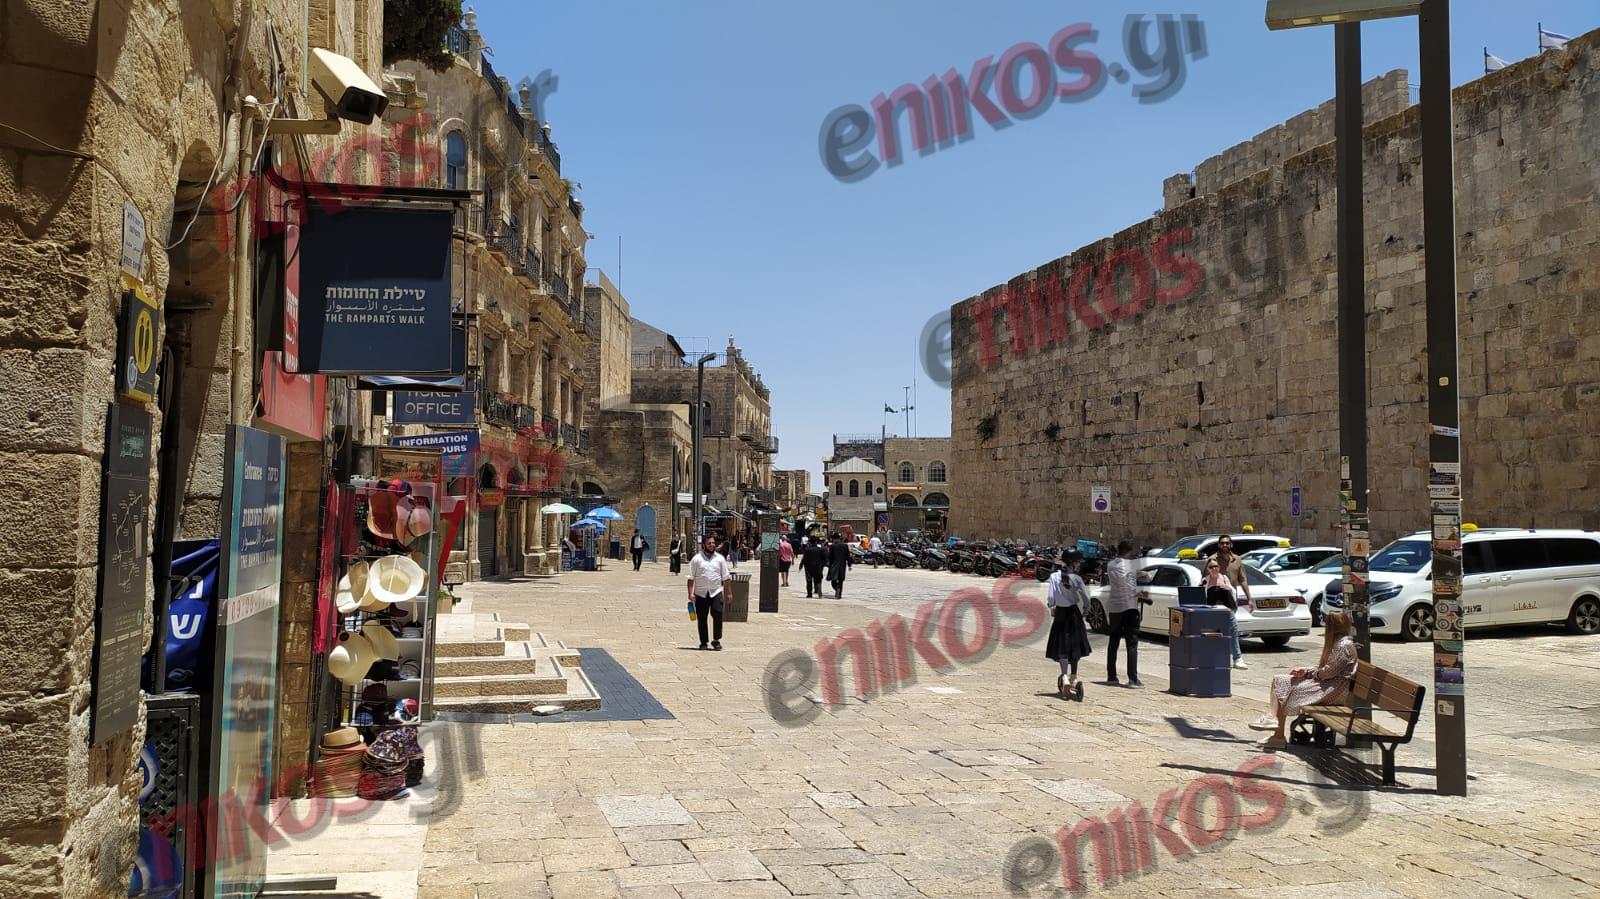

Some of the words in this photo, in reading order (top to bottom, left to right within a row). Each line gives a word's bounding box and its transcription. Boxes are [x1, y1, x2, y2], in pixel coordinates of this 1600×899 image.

[326, 286, 379, 300] החומות
[383, 286, 426, 300] טיילת
[325, 314, 343, 324] THE
[346, 314, 396, 325] RAMPARTS
[399, 315, 425, 325] WALK
[404, 402, 461, 415] OFFICE
[399, 434, 468, 447] INFORMATION
[442, 445, 467, 453] OURS
[170, 614, 202, 640] ש
